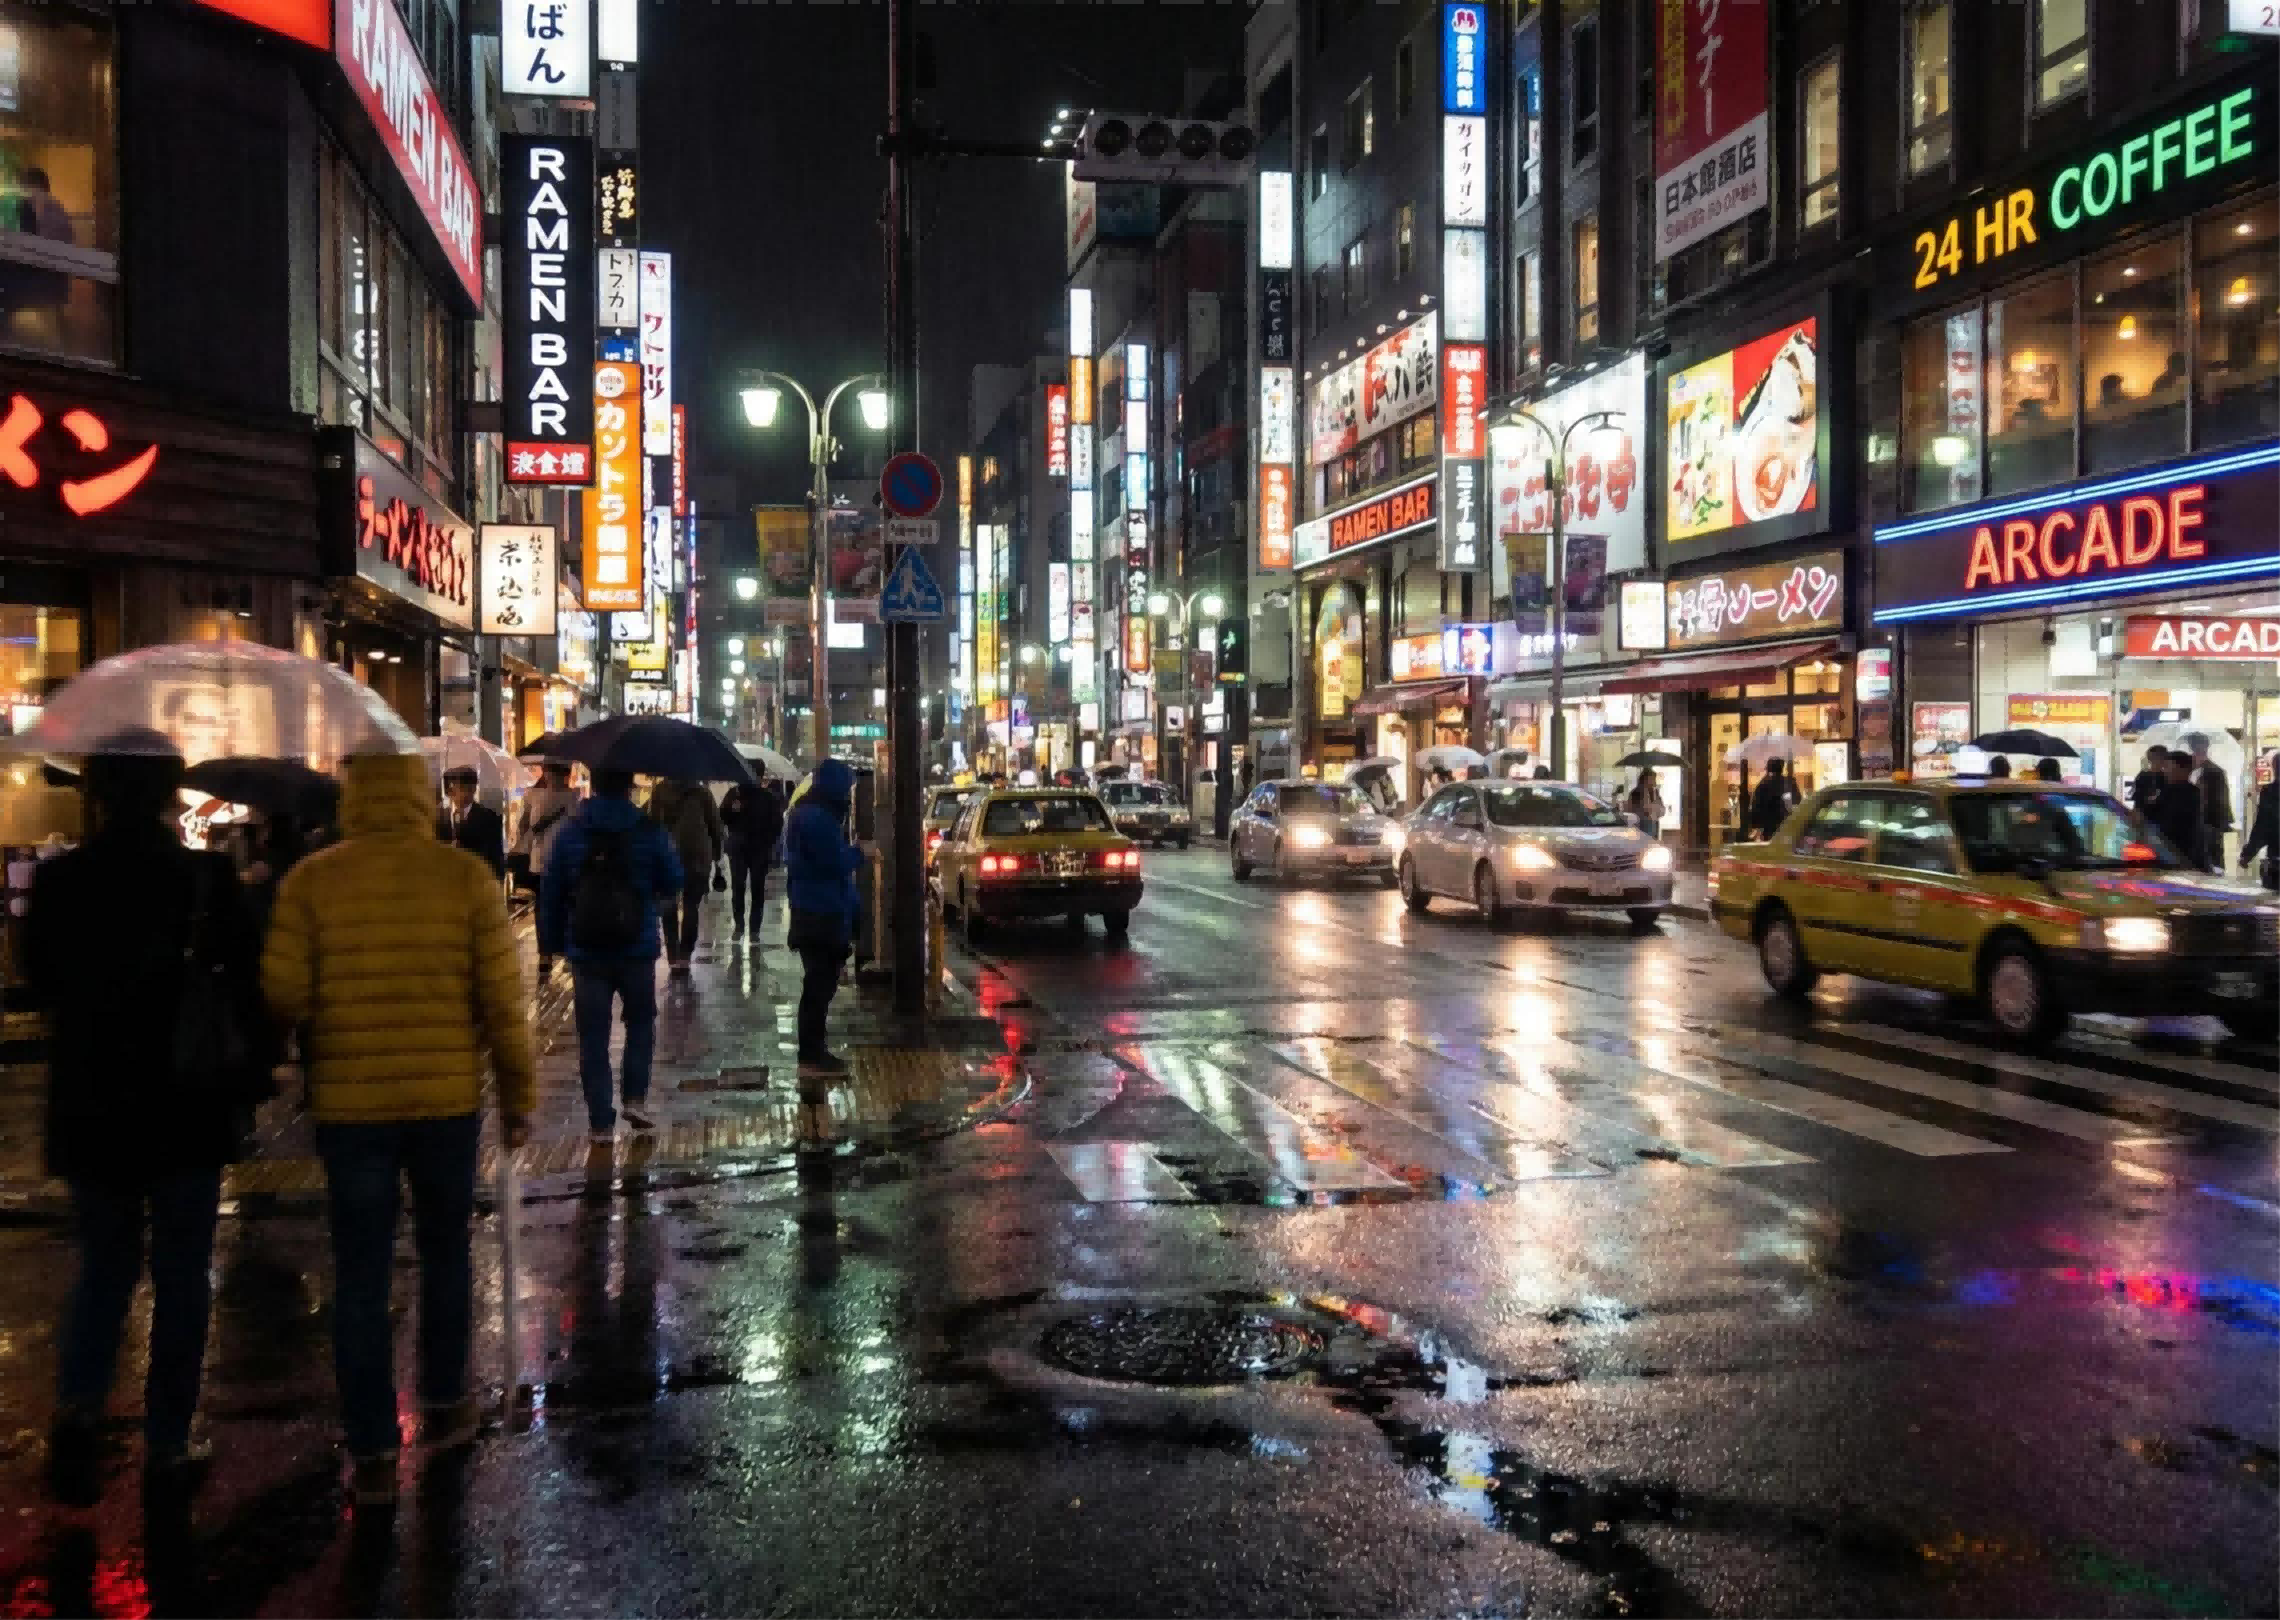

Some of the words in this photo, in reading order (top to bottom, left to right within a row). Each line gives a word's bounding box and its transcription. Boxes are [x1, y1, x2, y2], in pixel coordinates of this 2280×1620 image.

[526, 3, 567, 84] ばん
[440, 135, 474, 275] BAR
[527, 147, 569, 323] RAMEN
[1914, 219, 1963, 290] 24
[1976, 188, 2037, 264] HR
[2050, 87, 2253, 231] COFFEE
[528, 332, 570, 436] BAR
[1332, 500, 1389, 550] RAMEN
[1391, 486, 1430, 526] BAR
[1965, 484, 2205, 590] ARCADE
